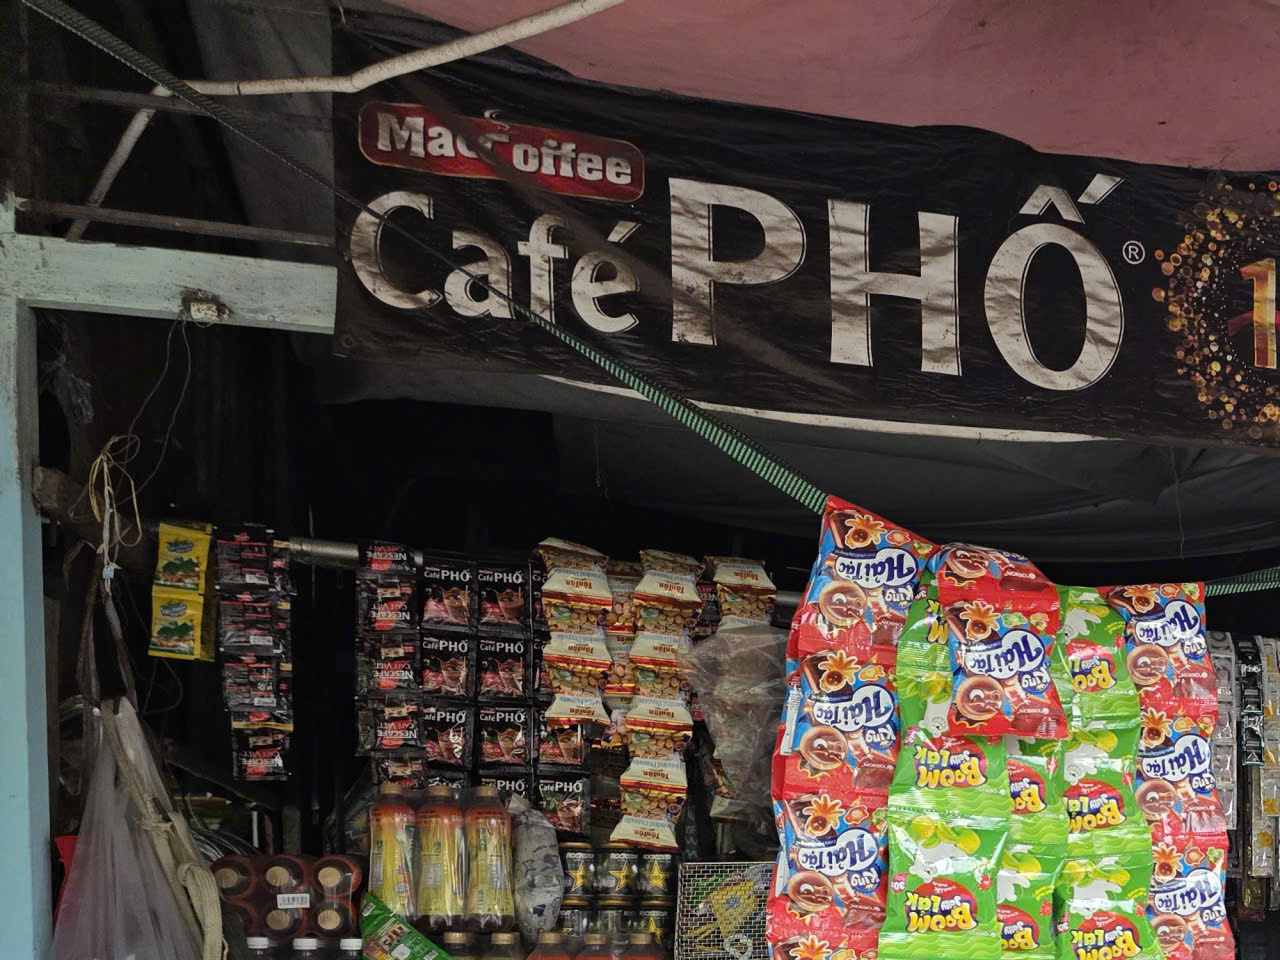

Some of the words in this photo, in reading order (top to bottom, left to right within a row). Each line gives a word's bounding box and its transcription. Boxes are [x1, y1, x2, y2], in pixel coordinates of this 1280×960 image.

[375, 111, 635, 187] Macoffee
[350, 190, 644, 335] Café
[668, 174, 1126, 392] PHỐ
[838, 560, 863, 581] Tặc
[864, 554, 915, 584] Hải
[968, 654, 993, 676] Tặc
[996, 642, 1042, 671] Hải
[1073, 658, 1115, 692] BOO
[424, 712, 436, 721] afé
[812, 700, 838, 721] Tặc
[840, 690, 892, 725] Hải
[1146, 759, 1167, 777] Tặc
[1167, 740, 1205, 773] Hải
[1011, 789, 1047, 813] BOO
[799, 848, 824, 871] Tặc
[825, 834, 878, 874] Hải
[1002, 927, 1039, 952] BOO
